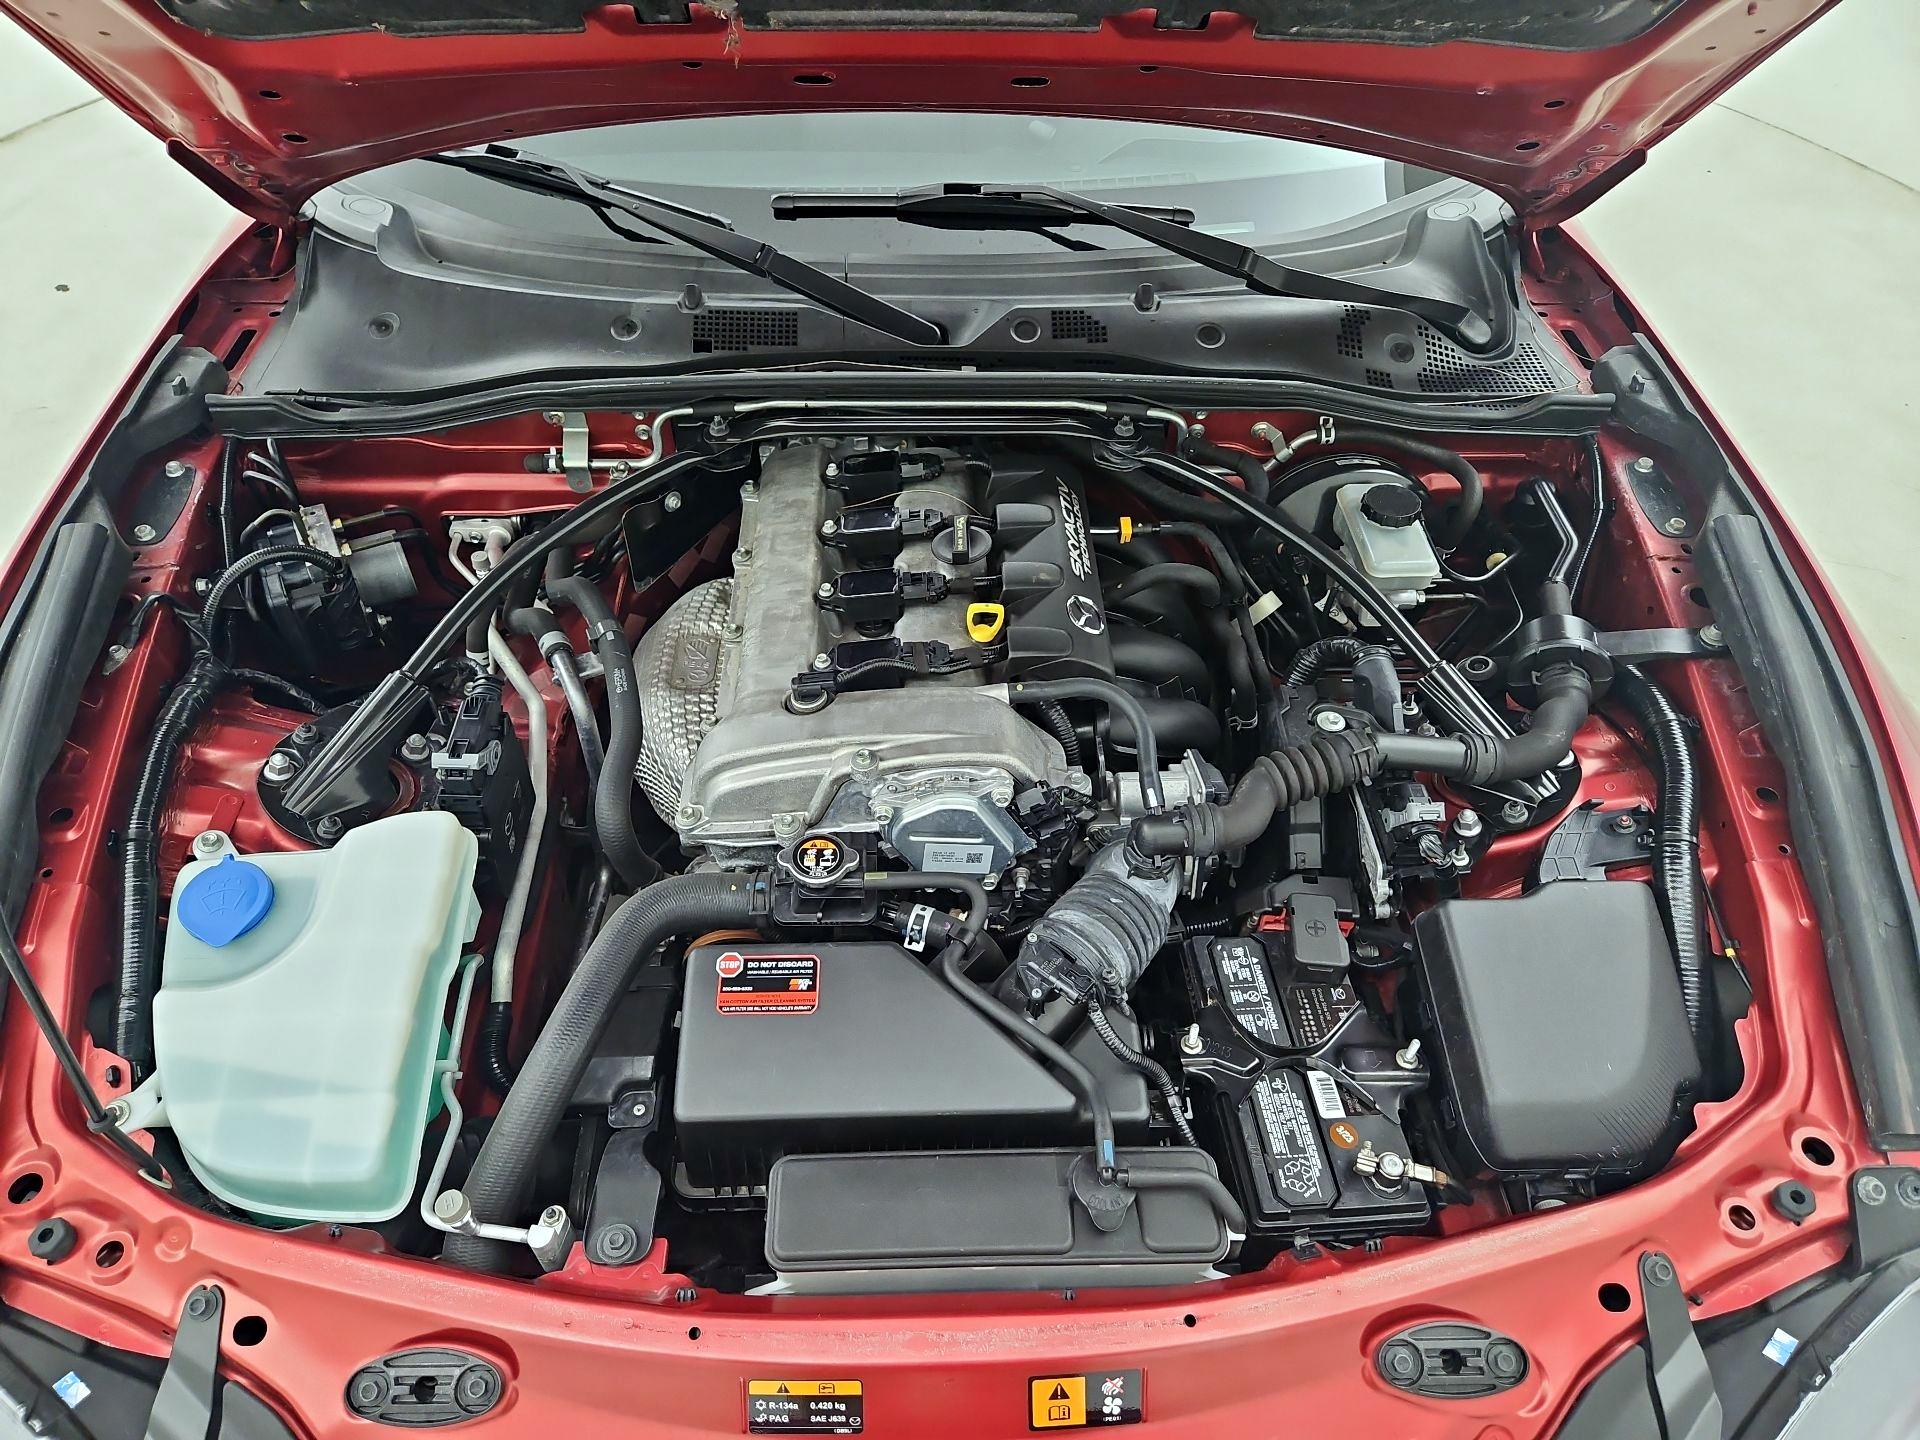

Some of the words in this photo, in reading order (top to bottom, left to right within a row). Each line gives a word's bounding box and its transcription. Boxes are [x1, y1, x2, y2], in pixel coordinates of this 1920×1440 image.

[1056, 476, 1085, 582] SKYACTIV
[1070, 490, 1092, 575] TECHNOLOGY
[720, 961, 740, 969] STOP
[1254, 965, 1268, 994] DANGER
[1265, 1001, 1279, 1029] POISON
[769, 1402, 799, 1410] R-134a
[810, 1402, 833, 1410] 0.420
[834, 1402, 846, 1411] kg
